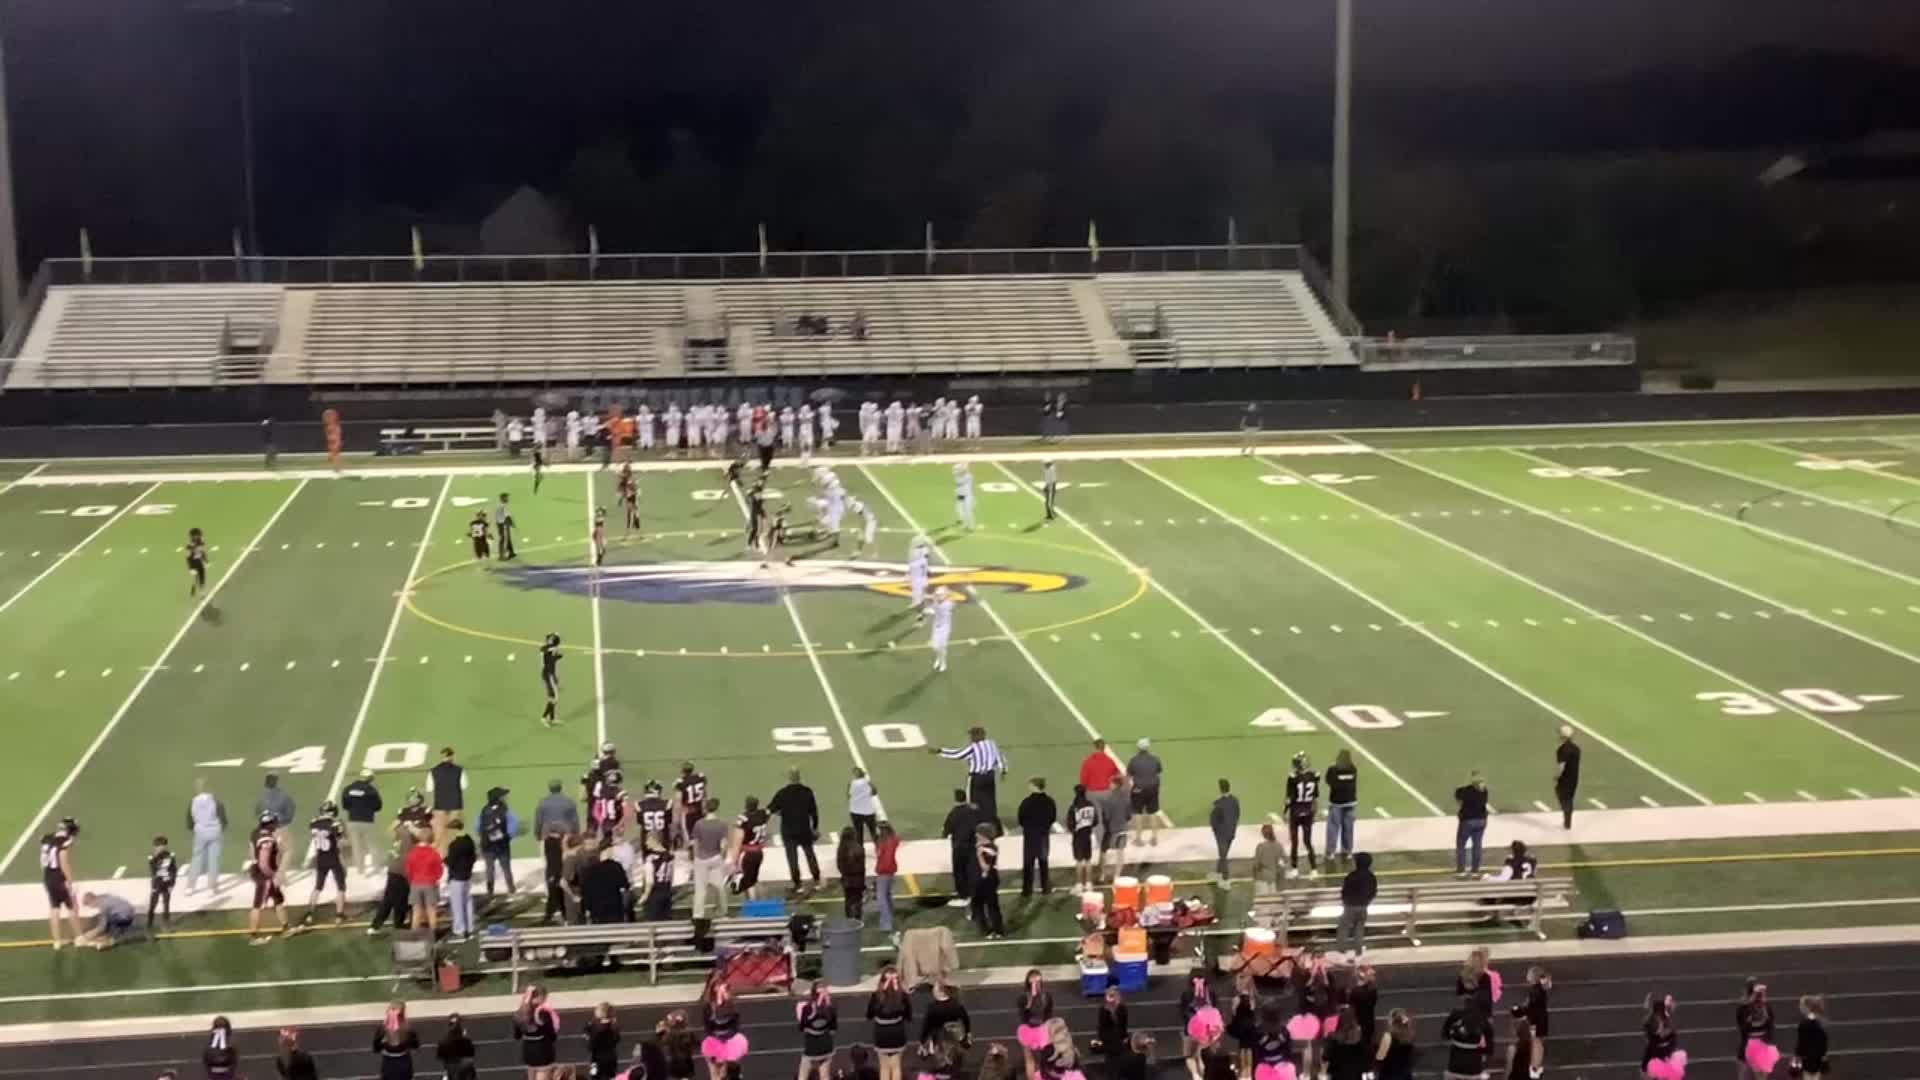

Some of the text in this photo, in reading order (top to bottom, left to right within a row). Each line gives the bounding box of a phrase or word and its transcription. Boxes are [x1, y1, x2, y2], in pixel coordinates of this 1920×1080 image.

[1696, 691, 1864, 715] 30
[1250, 704, 1404, 732] 40
[774, 724, 927, 753] 50
[260, 742, 428, 773] 40
[686, 783, 704, 804] 15
[1296, 782, 1315, 802] 12
